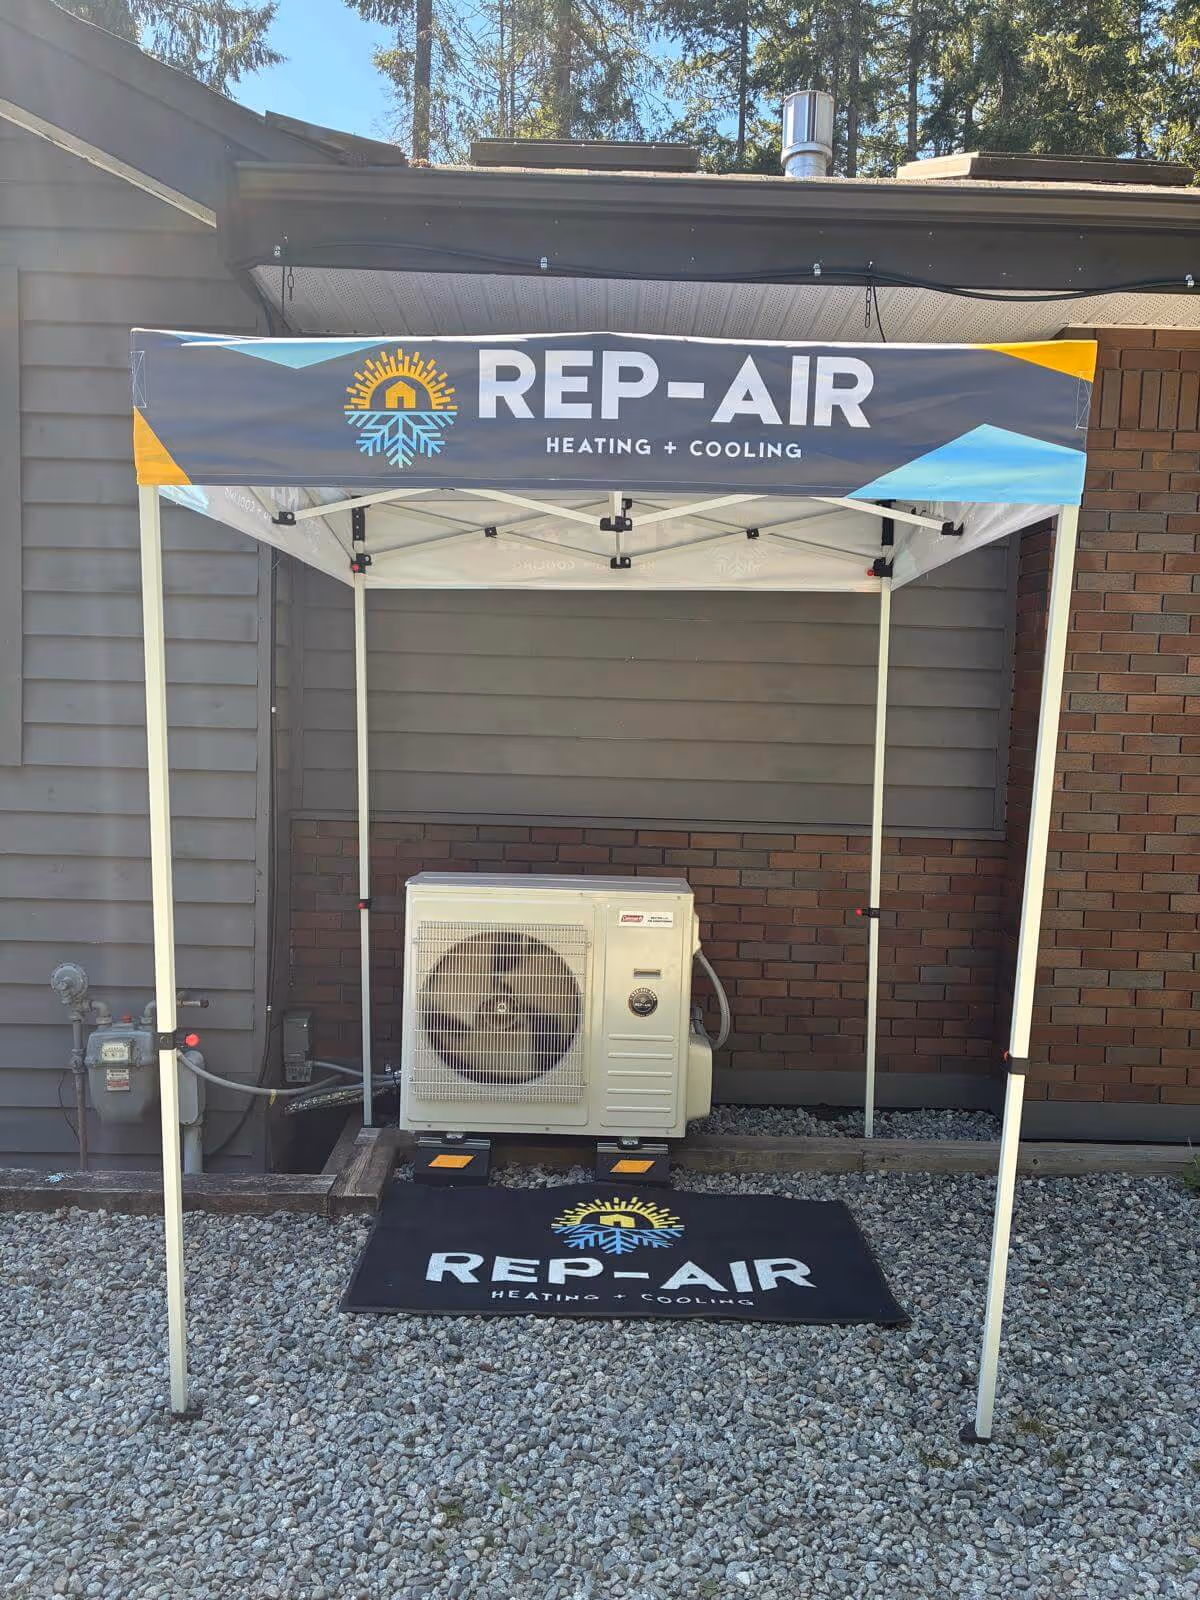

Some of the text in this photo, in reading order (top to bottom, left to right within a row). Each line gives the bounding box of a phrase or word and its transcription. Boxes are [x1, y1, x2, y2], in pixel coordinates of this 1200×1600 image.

[478, 349, 874, 429] REP-AIR
[546, 436, 803, 459] HEATING + COOLING
[425, 1252, 817, 1293] REP-AIR
[491, 1290, 600, 1301] HEATING
[640, 1293, 755, 1306] COOLING
